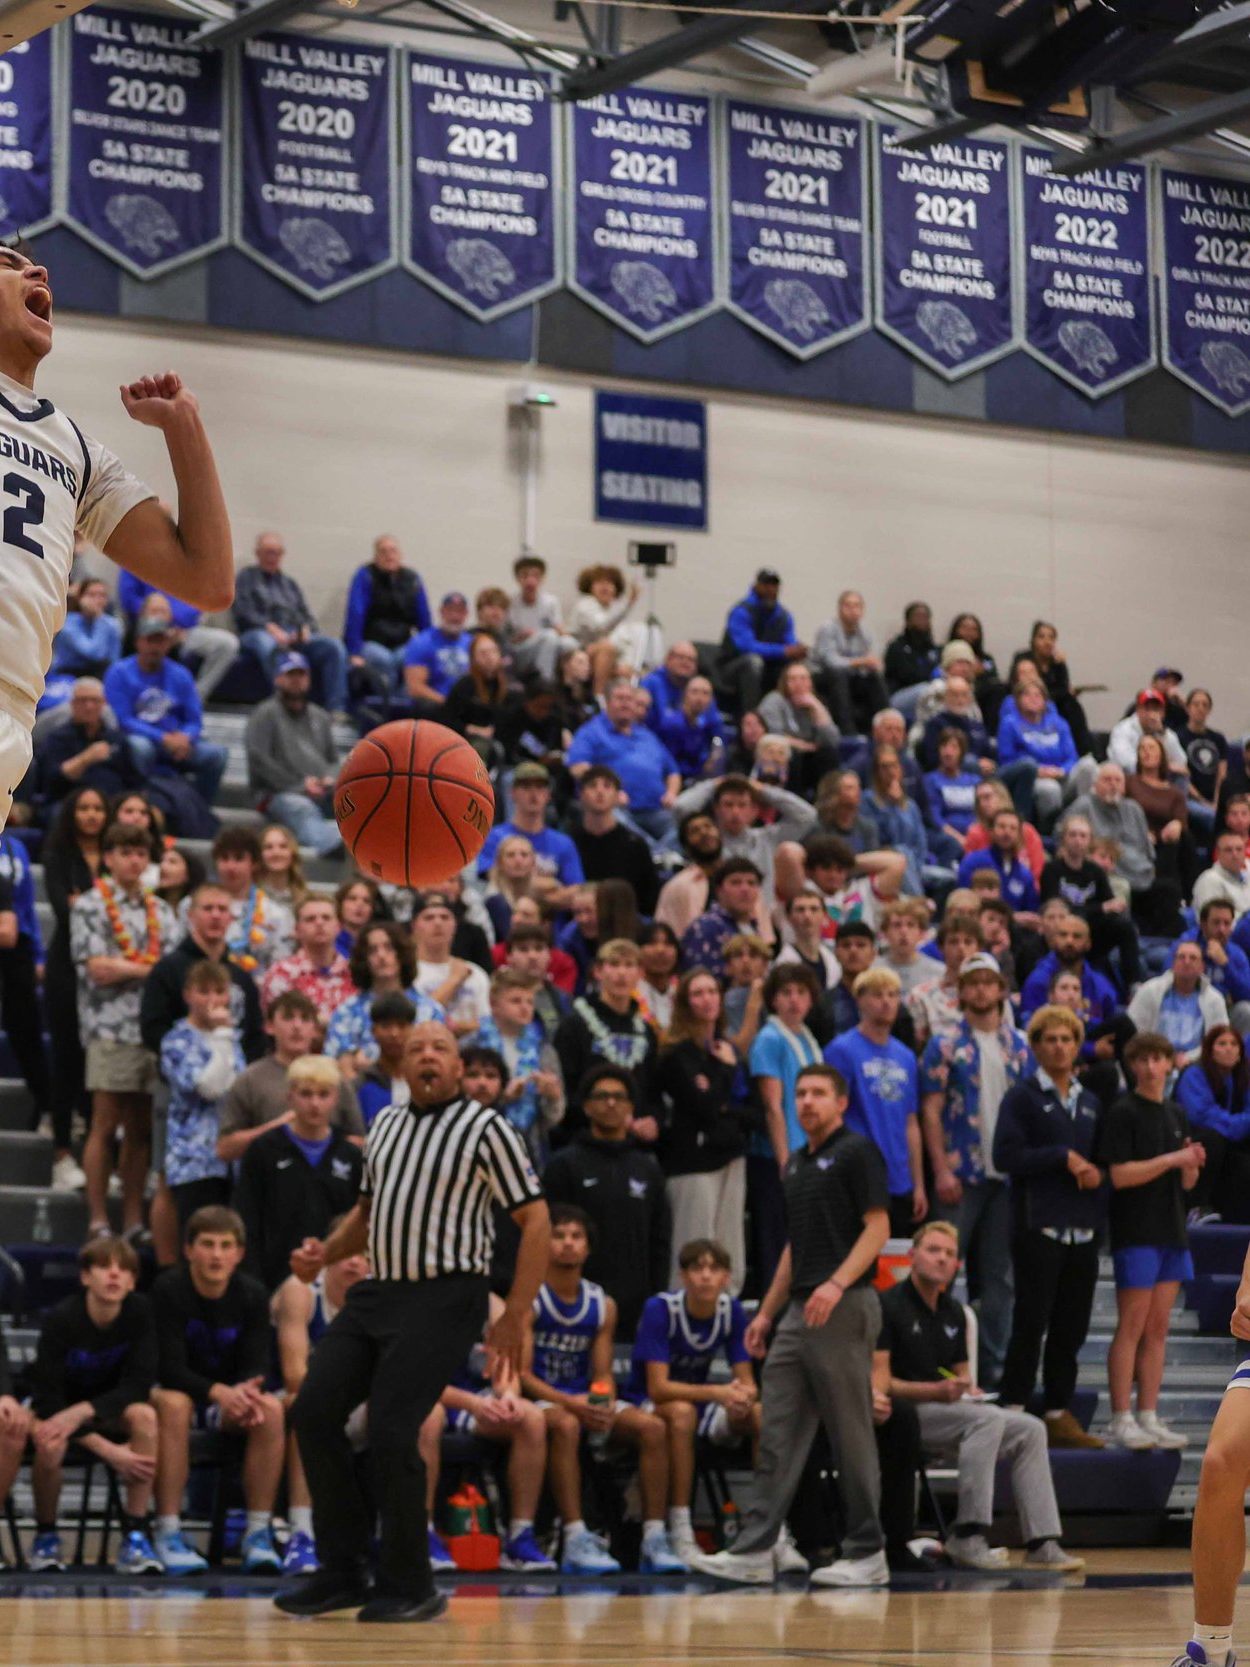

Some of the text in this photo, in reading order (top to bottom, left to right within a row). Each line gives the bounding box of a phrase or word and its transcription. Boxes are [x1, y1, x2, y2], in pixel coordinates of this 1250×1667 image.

[74, 12, 128, 42] MILL
[90, 43, 201, 78] JAGUARS
[245, 38, 386, 77] MILL VALLEY
[107, 75, 187, 116] 2020
[261, 68, 370, 101] JAGUARS
[411, 62, 545, 102] MILL VALLEY
[277, 100, 355, 140] 2020
[427, 91, 533, 127] JAGUARS
[626, 96, 707, 126] VALLEY
[447, 124, 518, 163] 2021
[591, 116, 692, 150] JAGUARS
[731, 109, 779, 137] MILL
[779, 117, 858, 148] VALLEY
[102, 138, 190, 169] 5A STATE
[277, 139, 354, 164] FOOTBALL
[610, 148, 678, 187] 2021
[747, 137, 843, 172] JAGUARS
[930, 143, 1005, 172] VALLEY
[88, 158, 204, 192] CHAMPIONS
[301, 167, 360, 192] STATE
[764, 168, 829, 207] 2021
[897, 161, 991, 195] JAGUARS
[1166, 178, 1208, 204] MILL
[261, 183, 374, 215] CHAMPIONS
[467, 188, 524, 214] STATE
[915, 192, 977, 230] 2021
[1039, 182, 1130, 216] JAGUARS
[429, 204, 538, 236] CHAMPIONS
[630, 211, 685, 236] STATE
[1054, 212, 1119, 250] 2022
[593, 227, 698, 259] CHAMPIONS
[784, 231, 835, 256] STATE
[1194, 234, 1250, 269] 2022
[748, 246, 848, 279] CHAMPIONS
[911, 250, 985, 279] 5A STATE
[1114, 257, 1145, 276] FIELD
[899, 268, 996, 301] CHAMPIONS
[1053, 270, 1124, 298] 5A STATE
[1043, 288, 1136, 320] CHAMPIONS
[602, 411, 701, 450] VISITOR
[602, 470, 701, 508] SEATING
[3, 471, 46, 560] 2
